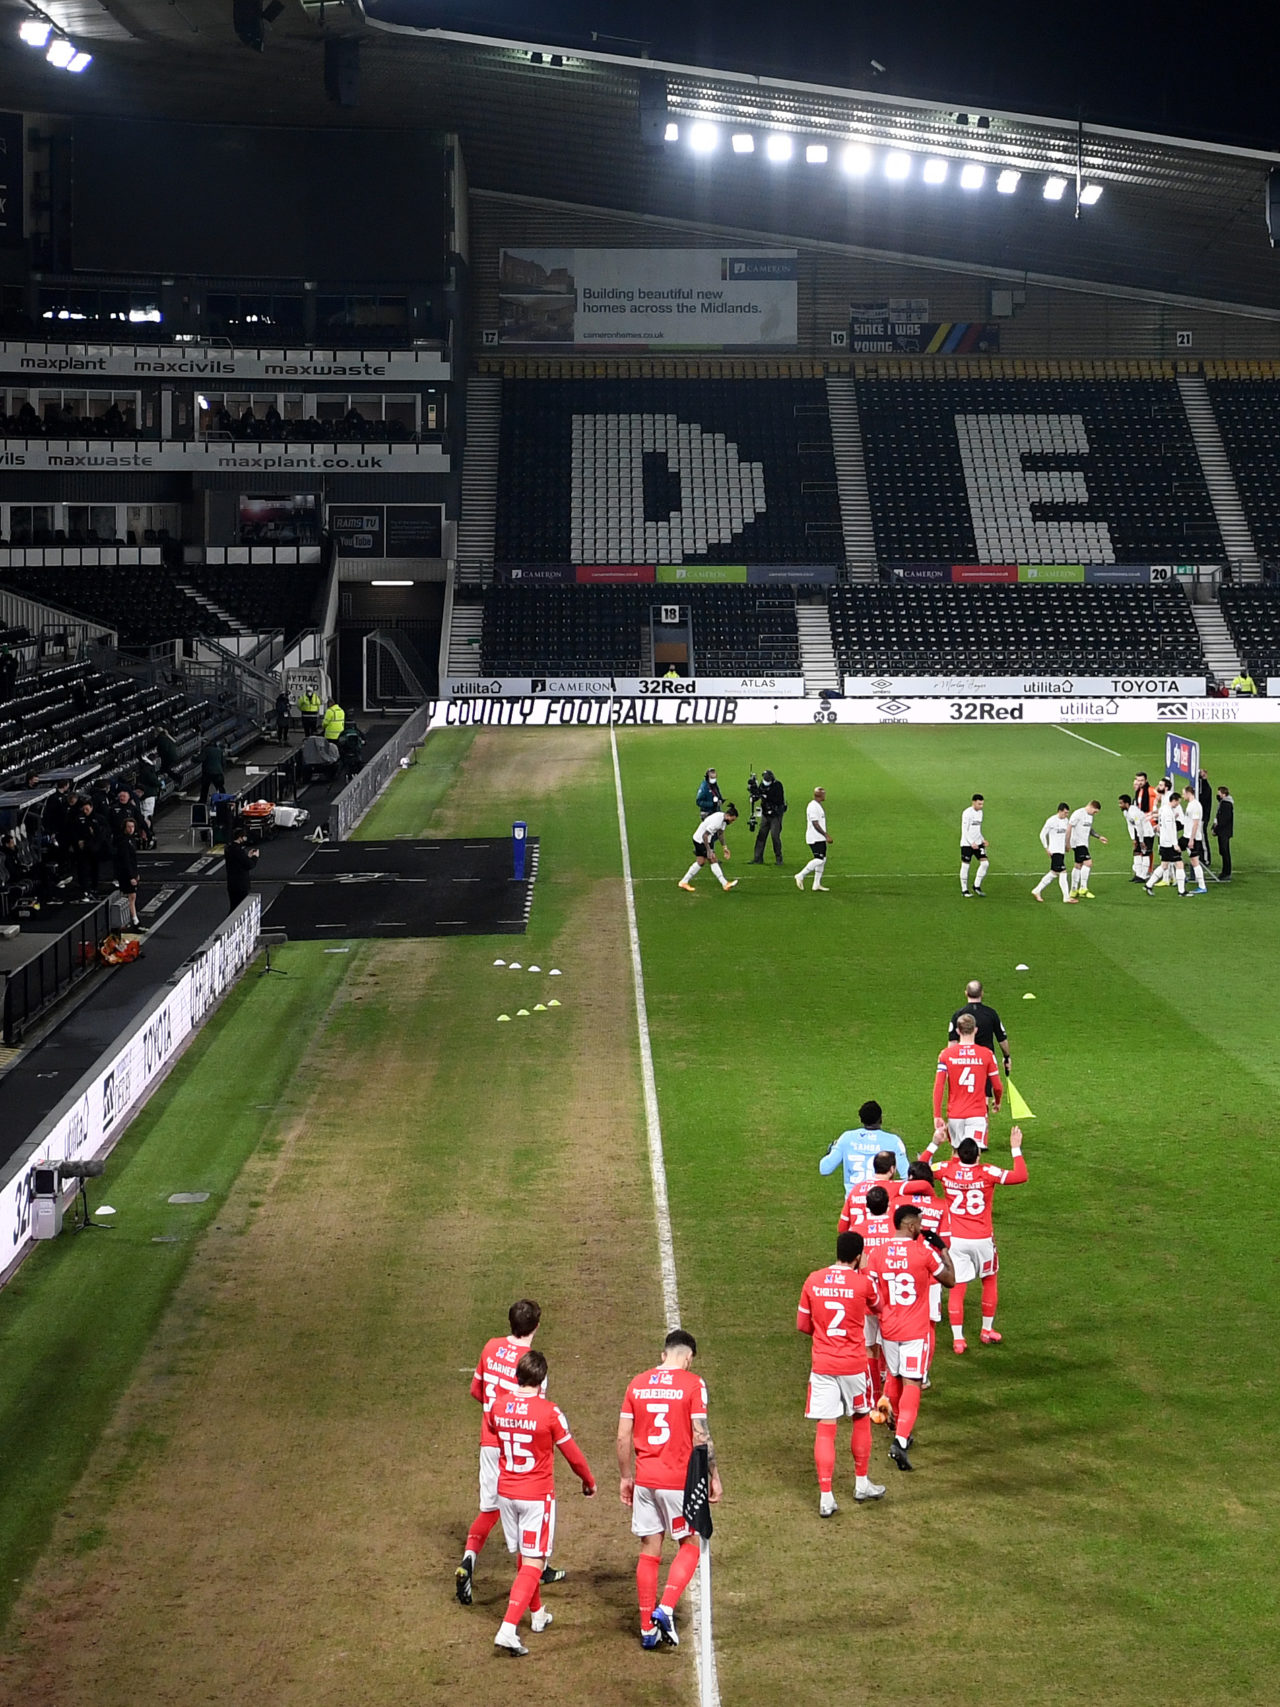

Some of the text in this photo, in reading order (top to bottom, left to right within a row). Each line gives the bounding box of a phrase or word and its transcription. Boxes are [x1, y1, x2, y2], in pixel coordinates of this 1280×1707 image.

[583, 288, 723, 302] Building beautiful new
[582, 302, 762, 314] homes across the Midlands.
[854, 324, 884, 336] SINCE
[894, 324, 921, 336] WAS
[484, 332, 497, 344] 17
[832, 333, 845, 344] 19
[1178, 334, 1191, 345] 21
[20, 356, 386, 377] maxplant maxcivils maxwaste
[48, 454, 153, 467] maxwaste
[218, 456, 383, 470] maxplant.co.uk
[336, 518, 378, 528] RAMS TV
[522, 571, 562, 579] CAMERON
[904, 570, 943, 579] CAMERON
[1152, 569, 1168, 580] 20
[663, 608, 677, 620] 18
[452, 680, 490, 694] utilita
[550, 682, 611, 696] CAMERON
[638, 680, 697, 694] 32Red
[741, 680, 776, 688] ATLAS
[1024, 681, 1062, 694] utilita
[1111, 680, 1180, 694] TOYOTA
[446, 699, 536, 726] COUNTY
[545, 698, 663, 725] FOOTBALL
[676, 698, 738, 724] CLUB
[950, 702, 1024, 720] 32Red
[1060, 702, 1104, 715] utilita
[1190, 706, 1240, 720] DERBY
[143, 1004, 172, 1080] TOYOTA
[951, 1057, 984, 1066] WORRALL
[958, 1066, 976, 1093] 4
[946, 1188, 986, 1216] 28
[815, 1288, 854, 1299] CHRISTIE
[882, 1272, 917, 1306] 18
[824, 1301, 847, 1337] 2
[488, 1360, 517, 1378] GARNER
[634, 1388, 684, 1400] FIGUEIREDO
[496, 1416, 536, 1431] FREEMAN
[646, 1404, 671, 1445] 3
[498, 1431, 536, 1473] 15
